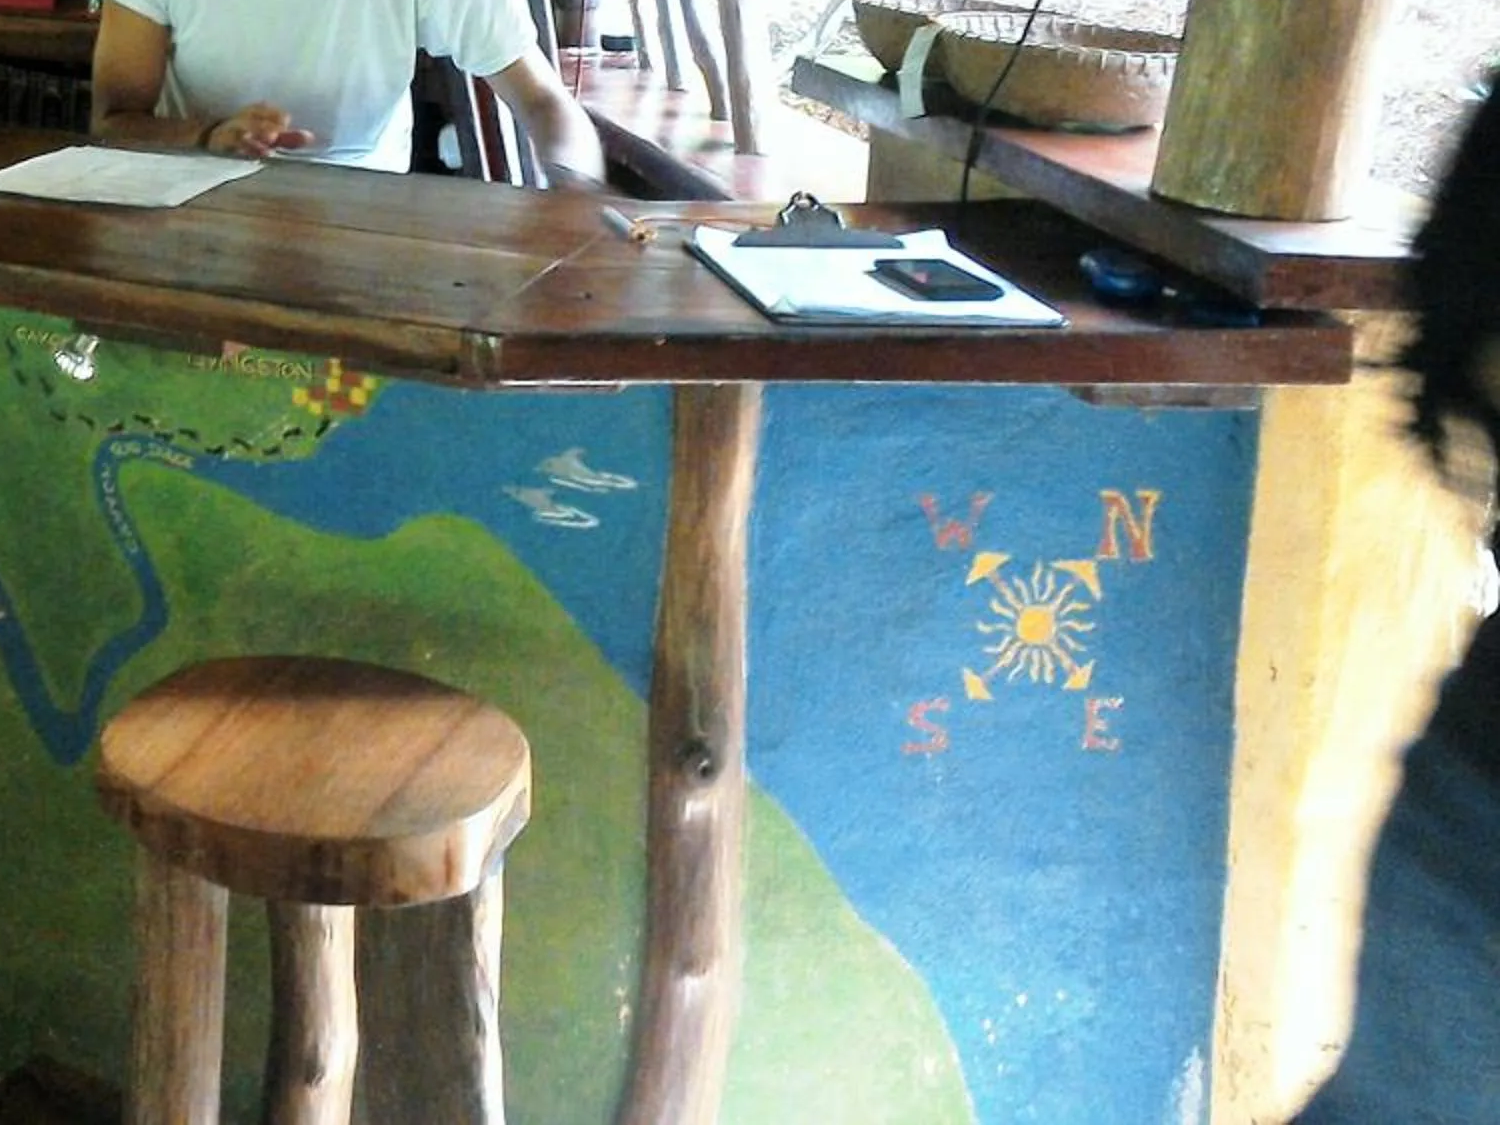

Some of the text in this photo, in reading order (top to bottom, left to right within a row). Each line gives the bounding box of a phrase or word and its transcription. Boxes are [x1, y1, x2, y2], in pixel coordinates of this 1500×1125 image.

[915, 489, 1162, 563] W N
[900, 695, 1125, 754] S E
